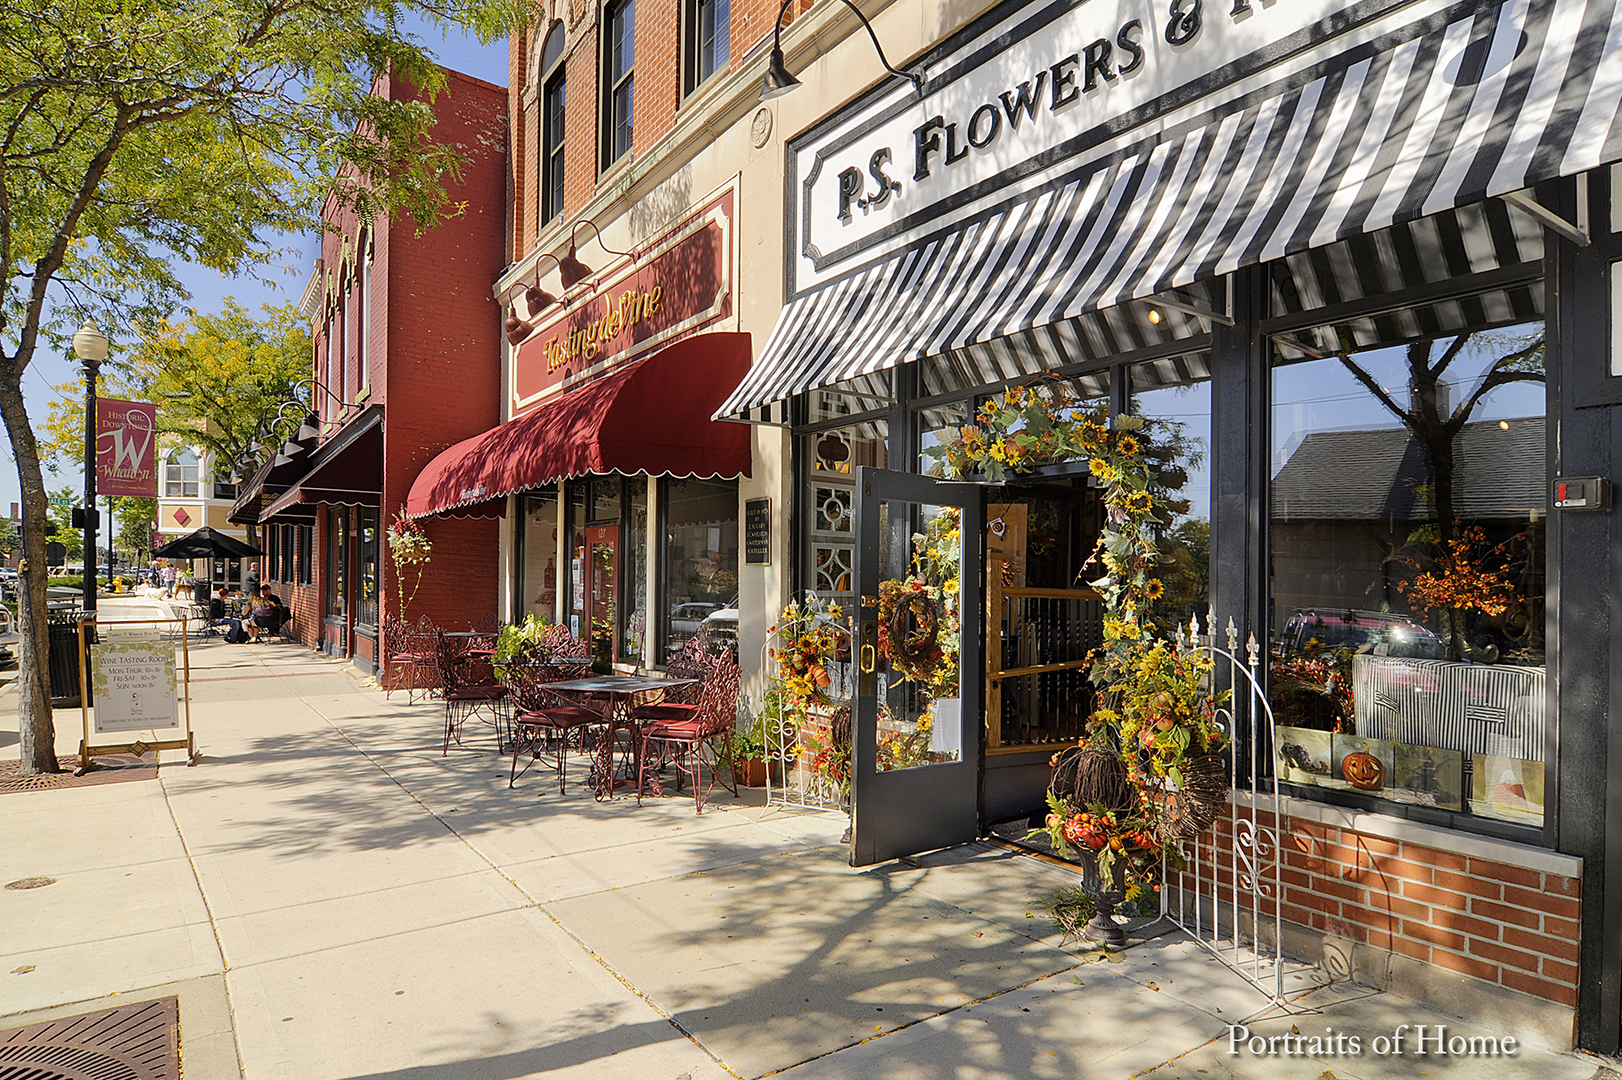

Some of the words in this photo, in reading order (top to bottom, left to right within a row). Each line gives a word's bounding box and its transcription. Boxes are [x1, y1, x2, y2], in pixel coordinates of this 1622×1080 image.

[837, 147, 901, 220] P.S.
[912, 19, 1144, 184] FLOWERS
[542, 332, 600, 373] Tasting
[108, 411, 145, 422] HISTORIC
[102, 420, 150, 430] DOWNTOWN
[598, 528, 606, 539] 127
[101, 657, 117, 665] WINE
[119, 656, 147, 664] TASTING
[148, 655, 169, 663] ROOM
